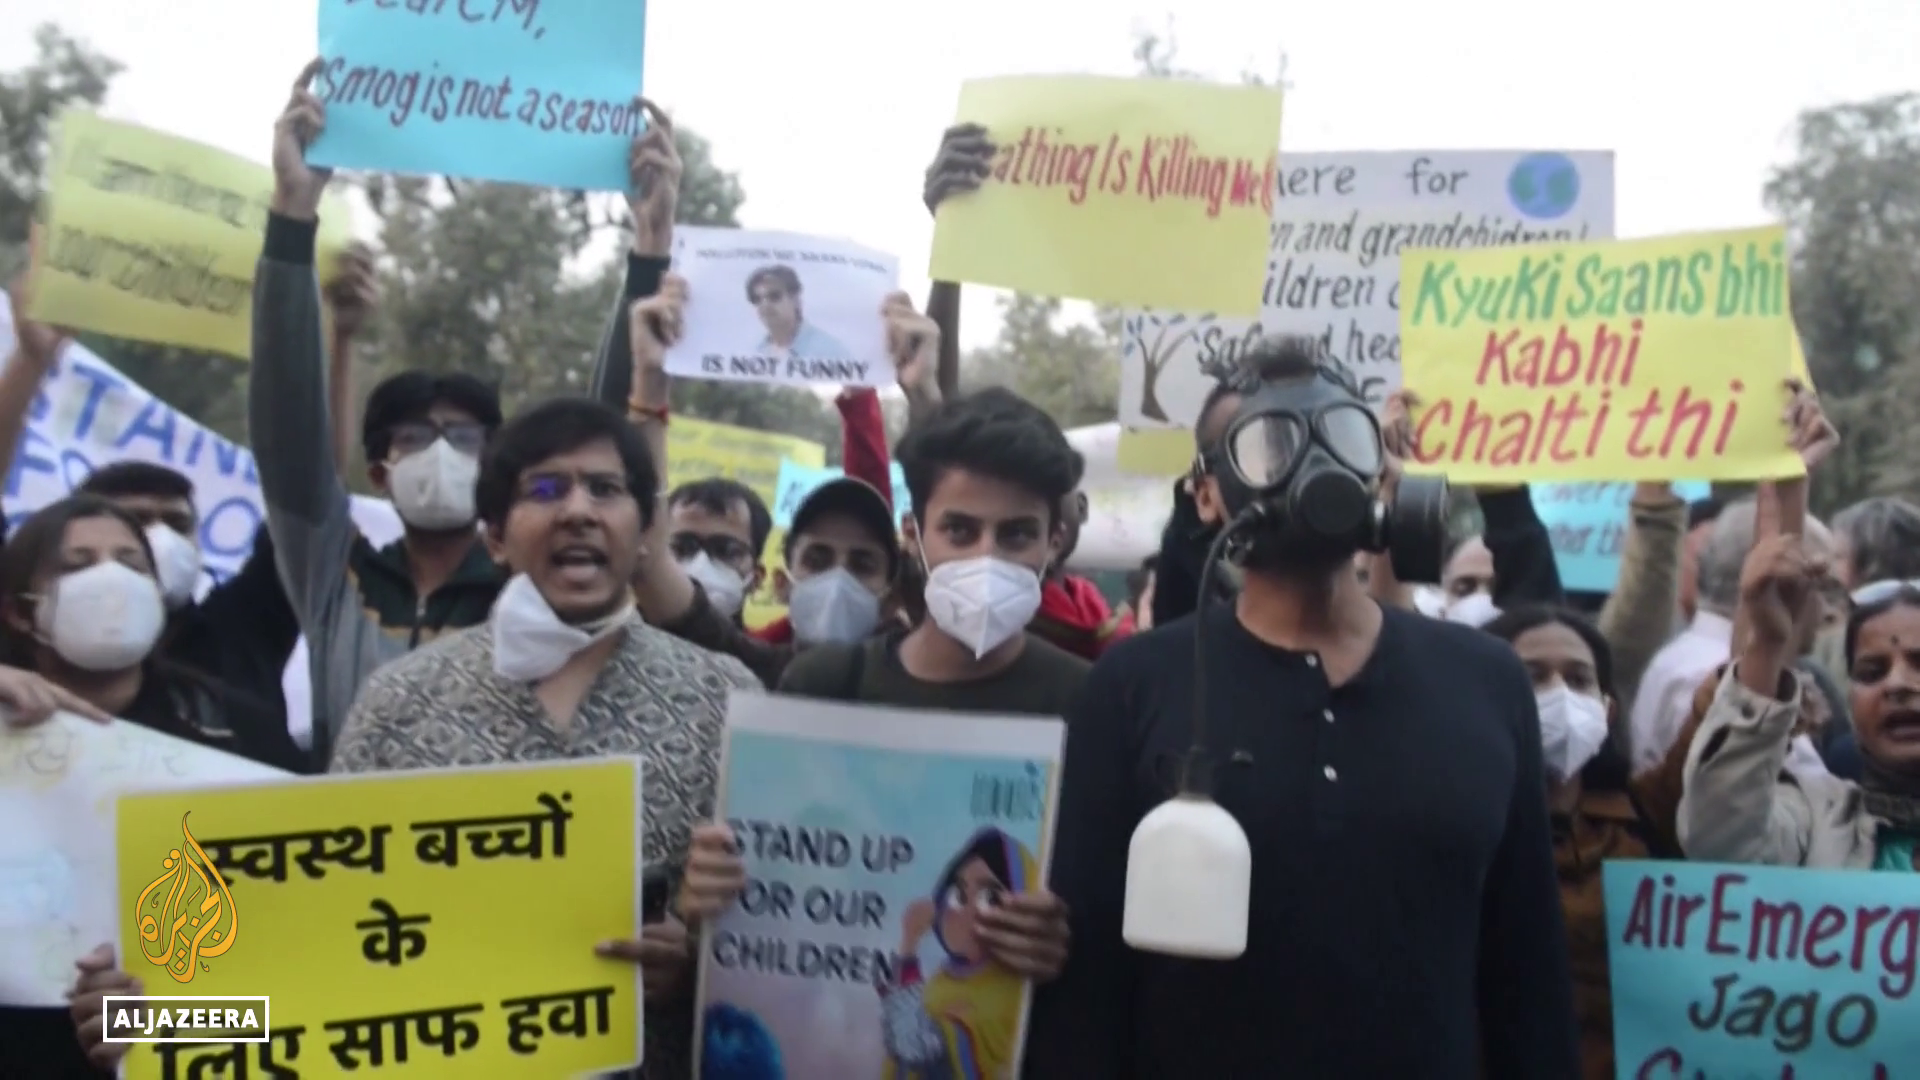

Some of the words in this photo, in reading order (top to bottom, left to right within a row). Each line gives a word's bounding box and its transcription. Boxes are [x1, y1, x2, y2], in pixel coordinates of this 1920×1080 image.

[988, 126, 1096, 205] athing
[1137, 135, 1228, 218] Killing
[1406, 157, 1468, 195] for
[1302, 208, 1359, 252] and
[1262, 257, 1376, 310] ildren
[1716, 241, 1784, 318] bhi
[702, 354, 724, 372] IS
[730, 356, 779, 377] NOT
[786, 357, 869, 381] FUNNY
[1476, 318, 1643, 387] Kabhi
[1412, 389, 1613, 466] Chalti
[1626, 378, 1745, 460] thi
[410, 793, 574, 868] बच्चों
[861, 834, 914, 874] UP
[356, 898, 431, 966] के
[738, 878, 796, 920] OR
[804, 885, 887, 931] OUR
[712, 930, 897, 985] CHILDREN
[324, 1003, 484, 1070] साफ
[501, 986, 615, 1055] हवा
[1688, 972, 1878, 1053] Jago
